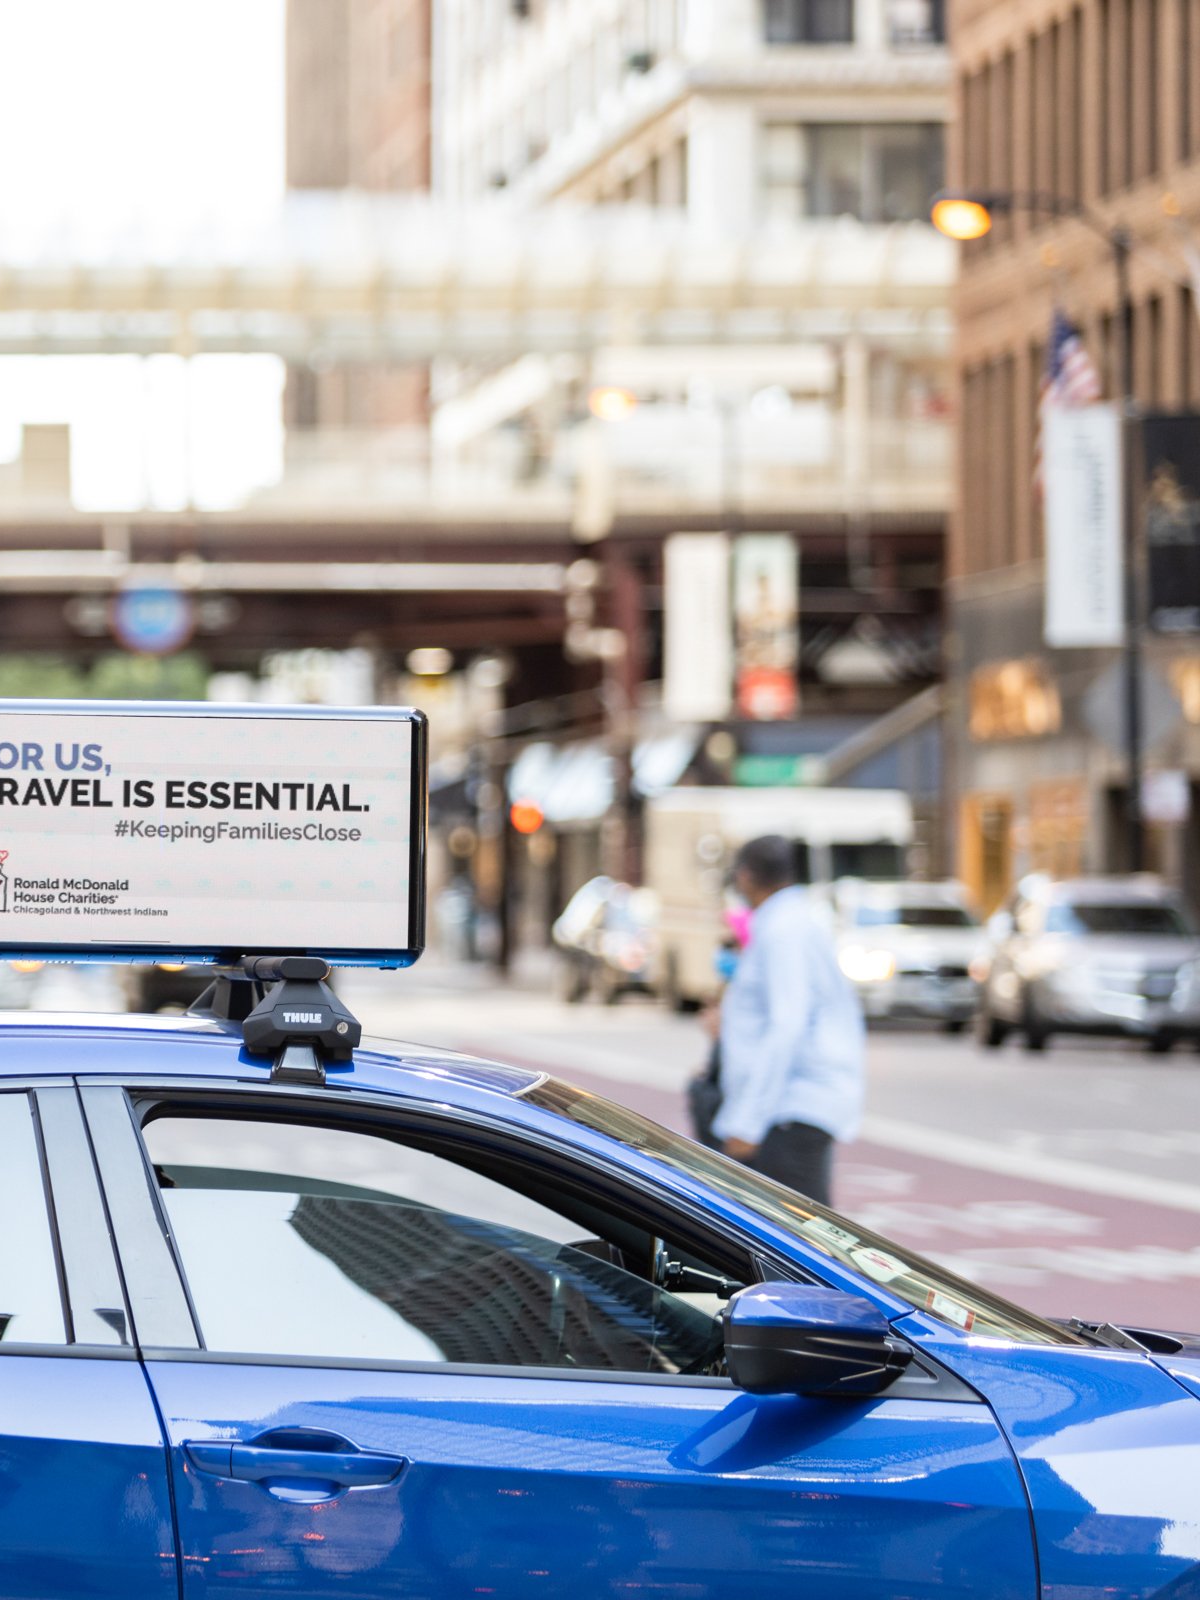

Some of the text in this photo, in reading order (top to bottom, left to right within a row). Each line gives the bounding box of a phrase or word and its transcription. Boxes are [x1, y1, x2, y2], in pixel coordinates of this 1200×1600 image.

[55, 743, 112, 776] US,
[124, 780, 154, 808] IS
[166, 781, 370, 812] ESSENTIAL.
[114, 820, 362, 843] #KeepingFamiliesClose
[14, 878, 129, 891] Ronald McDonald
[14, 892, 54, 903] House
[13, 906, 168, 916] Chicagoland & Northwest Indiana
[283, 1012, 322, 1023] THULE
